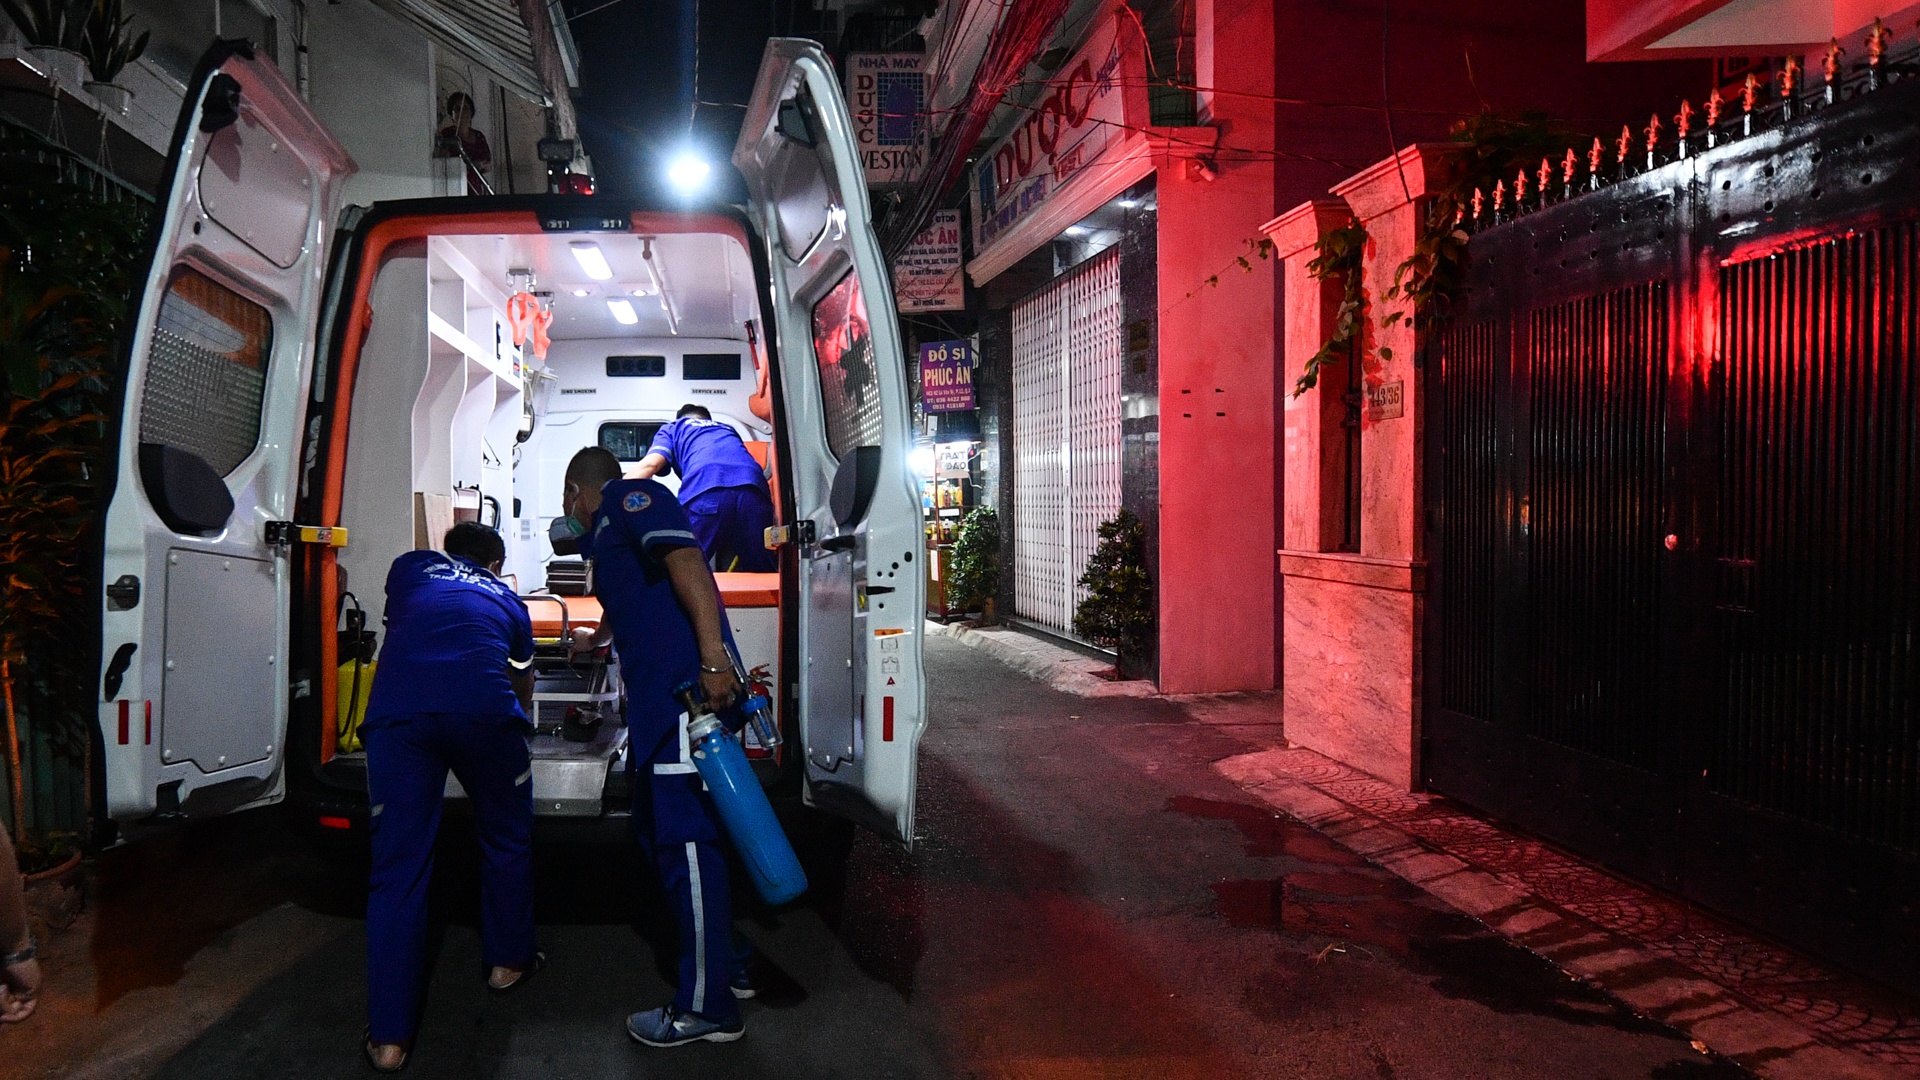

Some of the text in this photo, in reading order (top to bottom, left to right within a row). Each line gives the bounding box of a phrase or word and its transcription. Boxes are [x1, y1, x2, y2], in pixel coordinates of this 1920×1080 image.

[952, 347, 965, 360] SI
[924, 362, 971, 387] PHÚC ÂN
